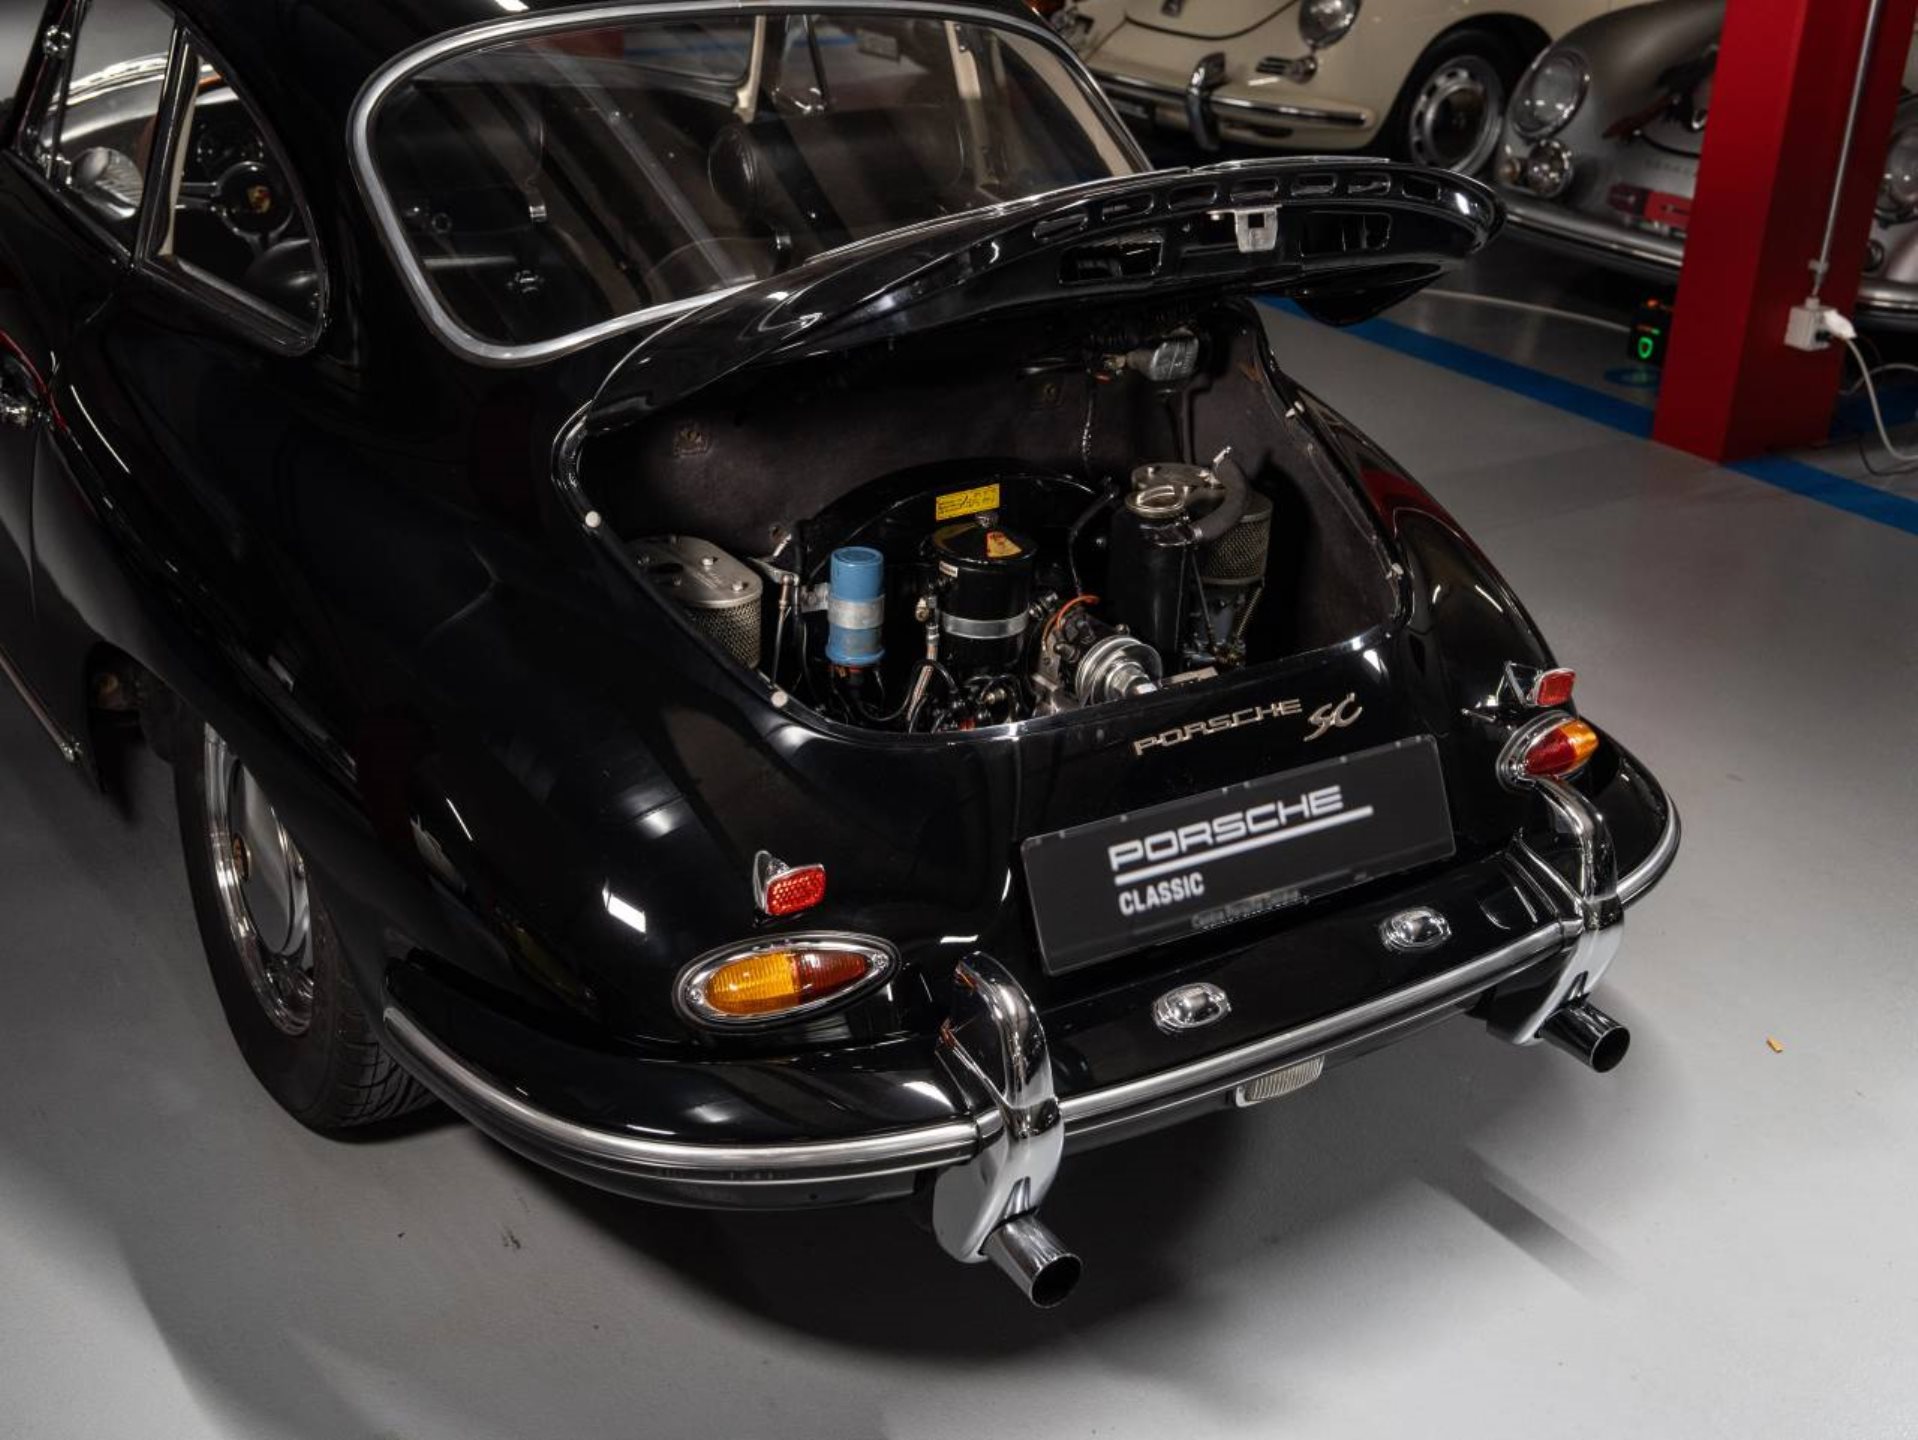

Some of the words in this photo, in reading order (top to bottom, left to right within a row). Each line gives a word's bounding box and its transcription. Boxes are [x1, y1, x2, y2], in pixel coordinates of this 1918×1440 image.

[1133, 699, 1302, 756] PORSCHE
[1303, 693, 1364, 742] SC
[1107, 785, 1344, 872] PORSCHE
[1118, 873, 1206, 916] CLASSIC
